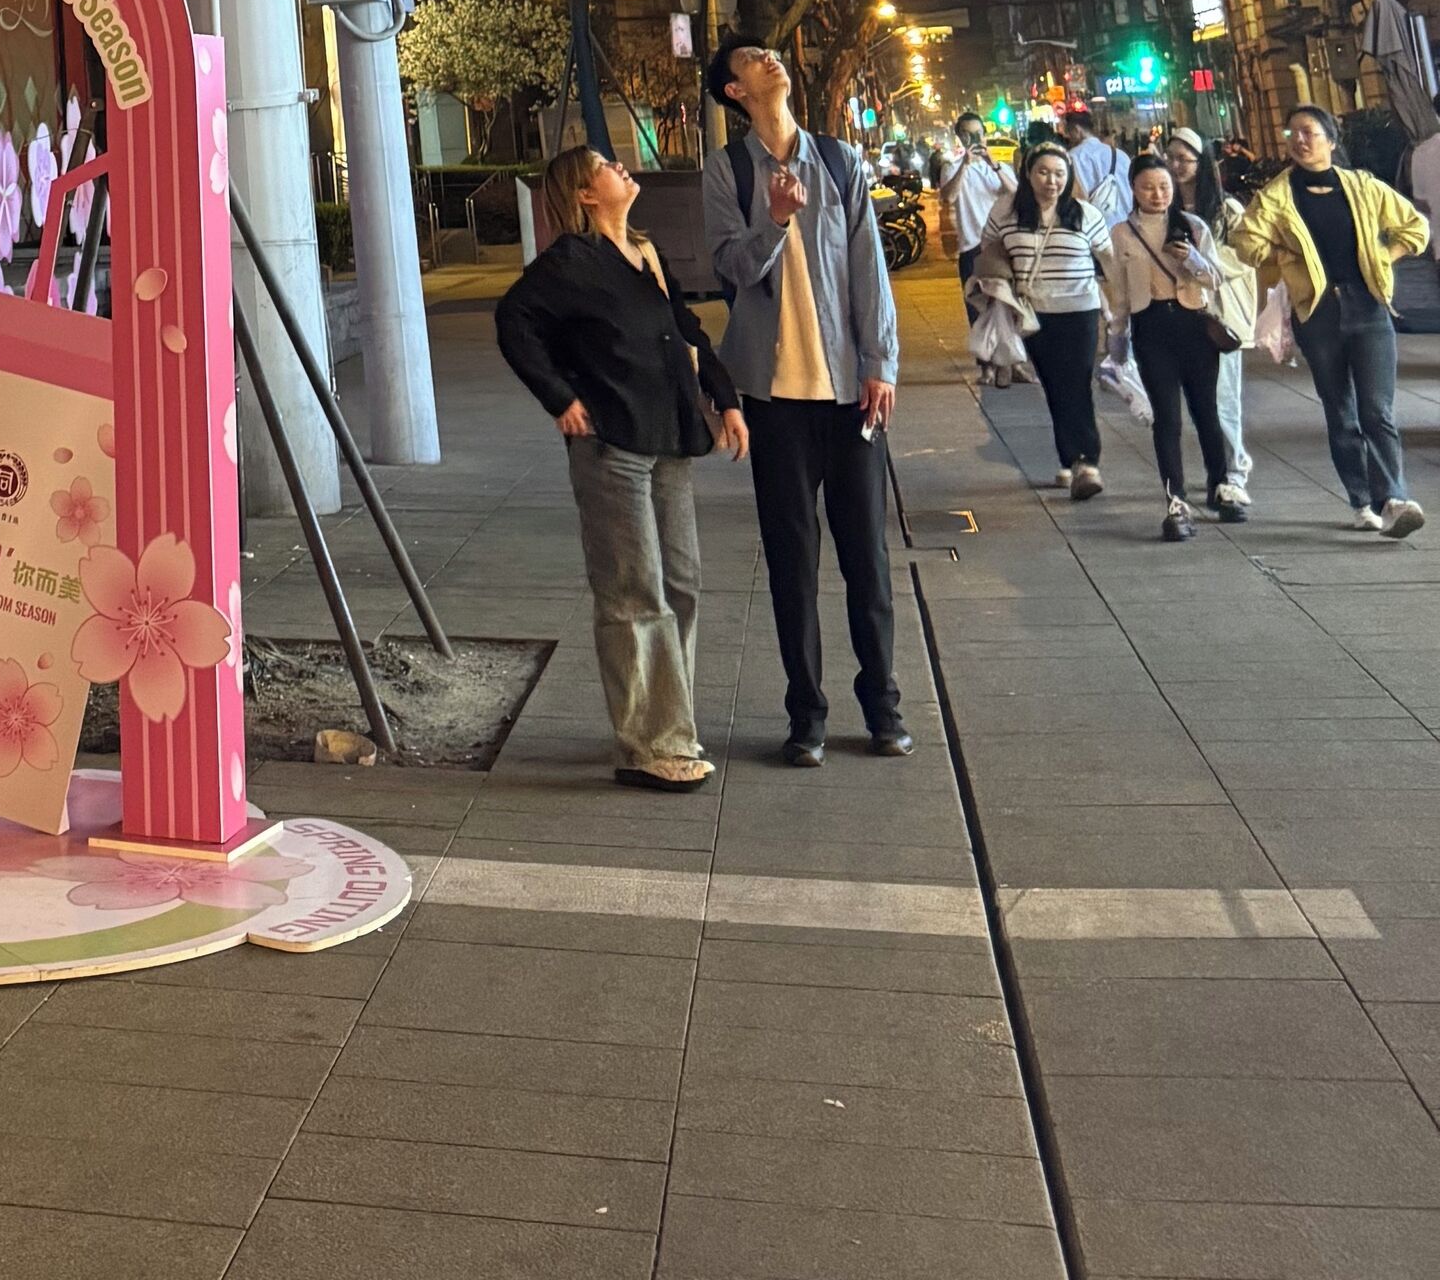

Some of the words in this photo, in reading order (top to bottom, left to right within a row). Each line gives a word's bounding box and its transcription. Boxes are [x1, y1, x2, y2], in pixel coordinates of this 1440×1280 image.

[15, 601, 57, 626] SEASON
[283, 823, 387, 875] SPRING
[268, 881, 387, 936] OUTING
